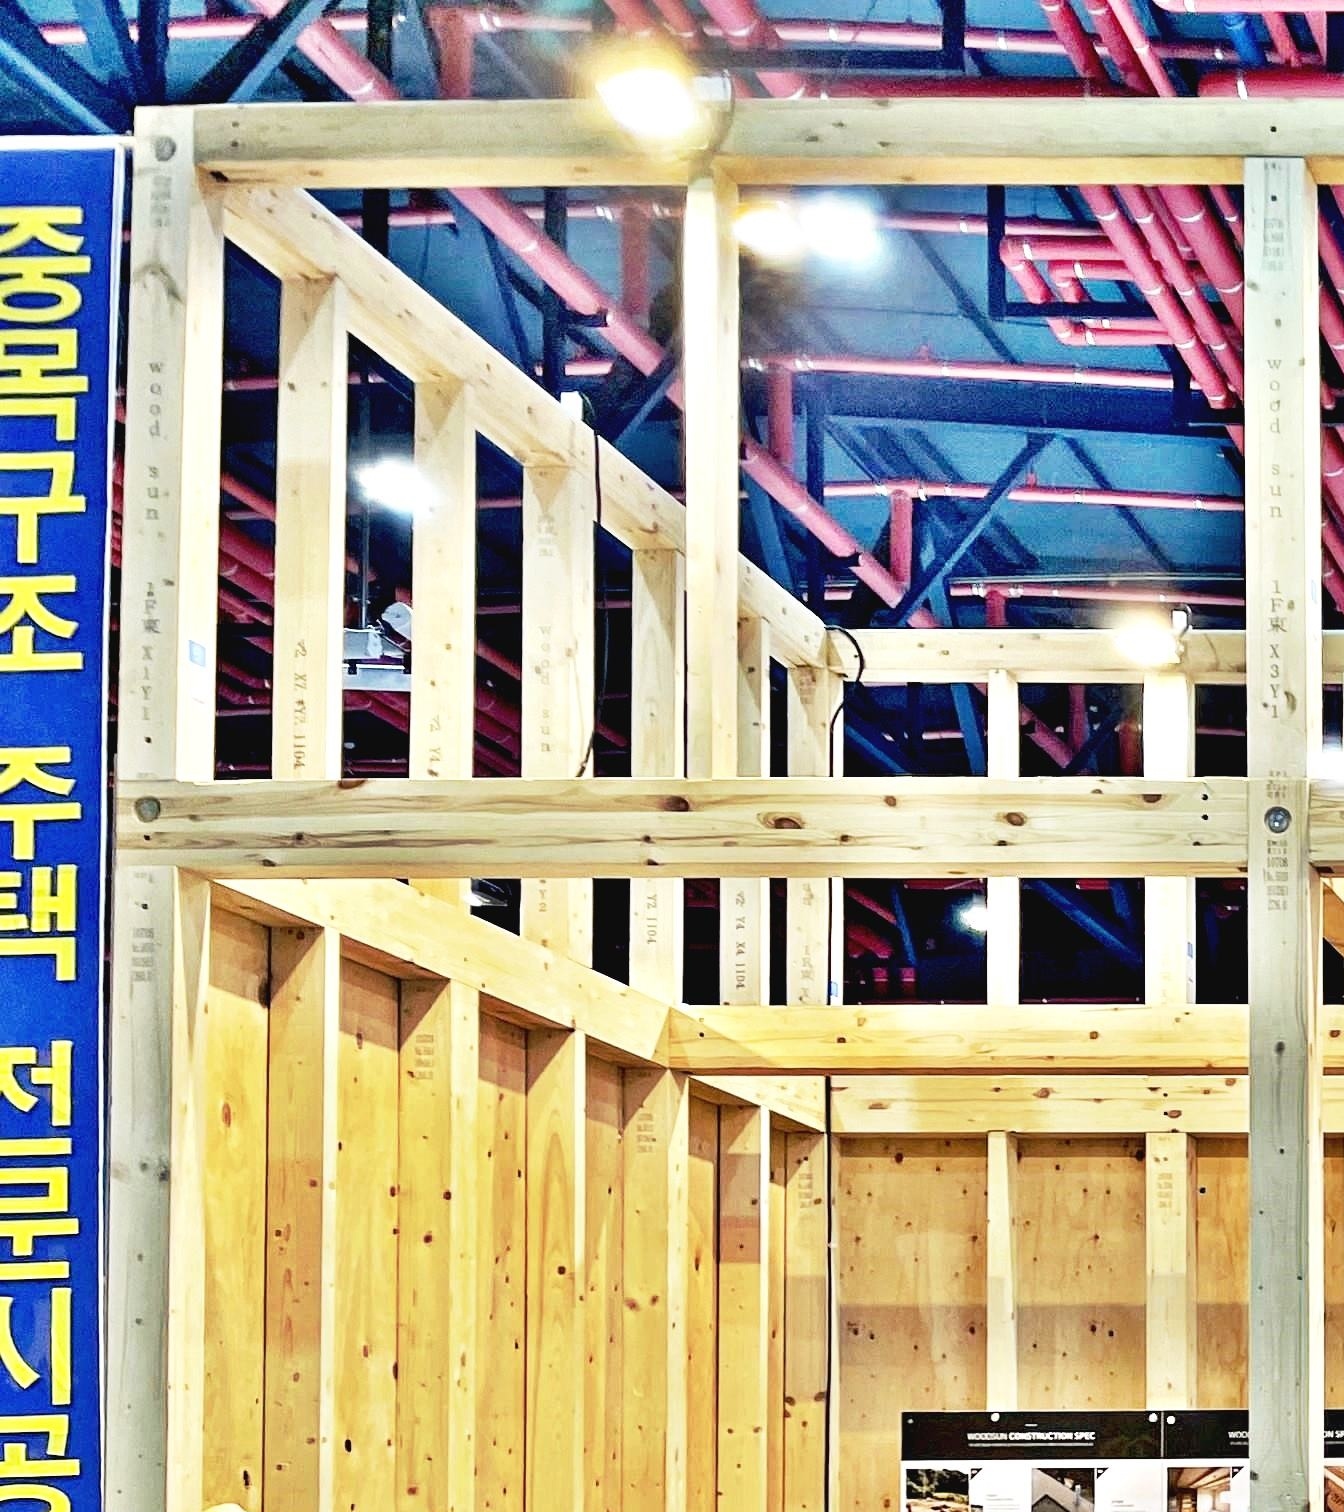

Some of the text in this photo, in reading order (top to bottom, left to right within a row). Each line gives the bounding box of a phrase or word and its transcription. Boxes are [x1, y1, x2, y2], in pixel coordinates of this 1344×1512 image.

[148, 361, 164, 439] wood
[1267, 357, 1283, 435] wood
[0, 206, 90, 672] 중목구조
[146, 465, 159, 521] sun
[1268, 463, 1283, 519] sun
[1268, 643, 1281, 720] X3Y1
[0, 747, 82, 982] 주택
[1074, 1431, 1096, 1441] SPEC
